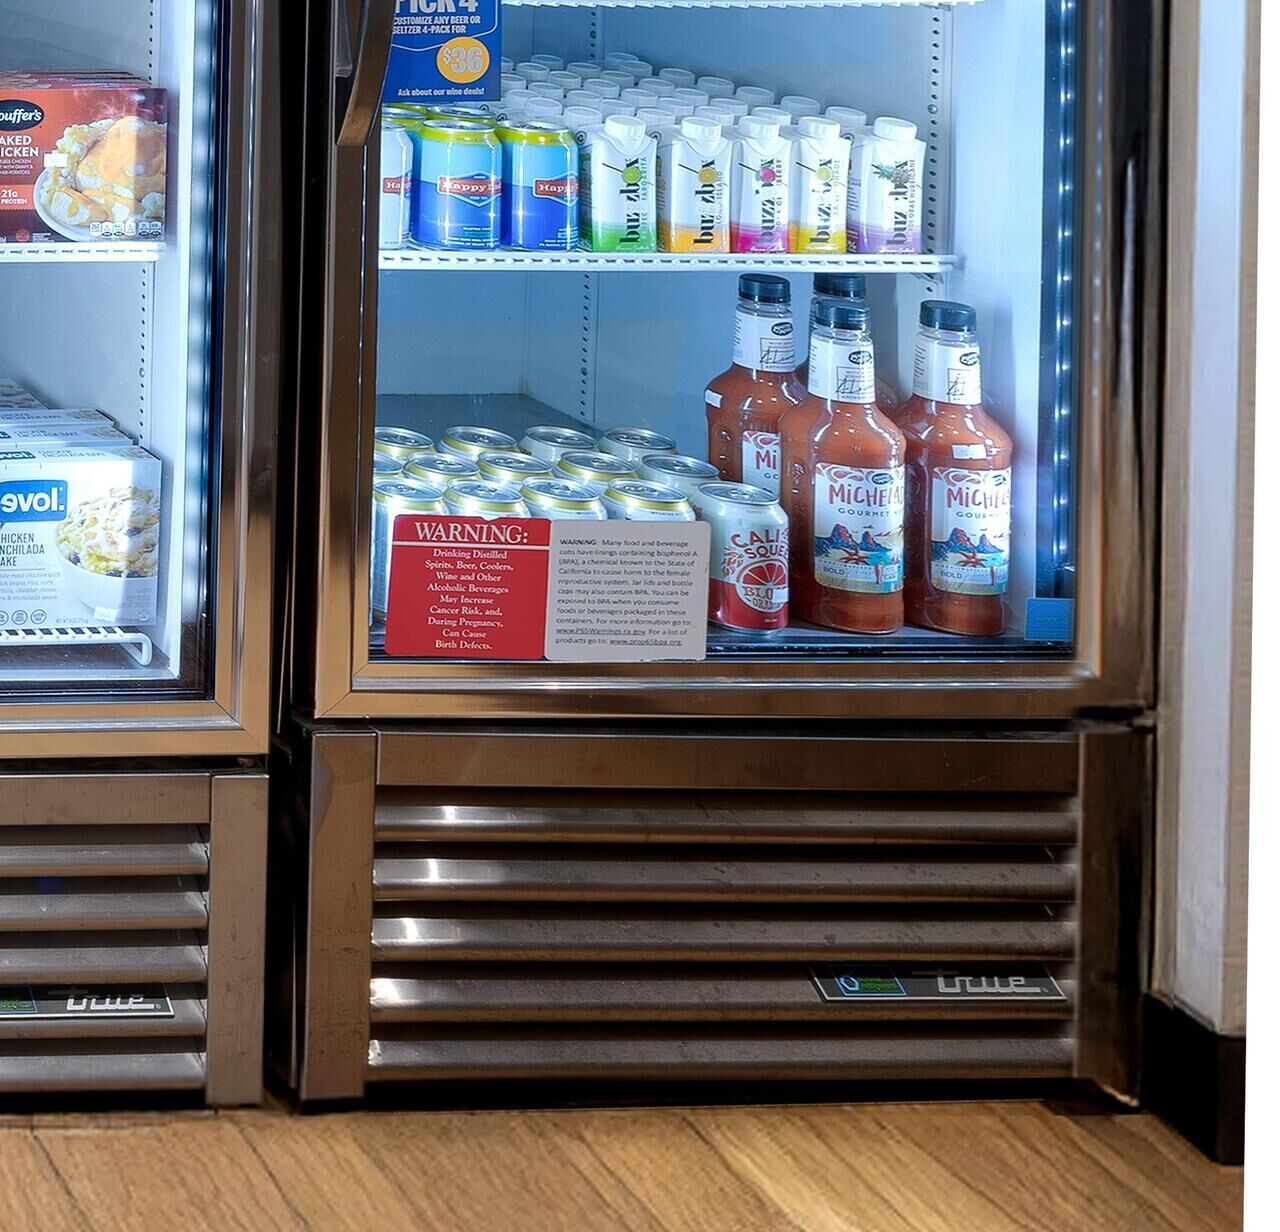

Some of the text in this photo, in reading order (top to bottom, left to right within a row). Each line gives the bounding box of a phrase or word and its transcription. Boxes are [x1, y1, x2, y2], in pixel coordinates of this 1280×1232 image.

[393, 16, 481, 25] CUSTOMIZE ANY BEER OR
[392, 25, 467, 35] SELTZER 4-PACK FOR
[443, 46, 484, 74] $36
[398, 88, 411, 97] Ask
[411, 88, 433, 96] about
[463, 87, 485, 95] deals!
[415, 522, 529, 544] WARNING:
[433, 548, 508, 559] Drinking Distilled
[436, 571, 502, 582] Wine and Other
[426, 583, 509, 594] Alcoholic Beverages
[439, 595, 495, 605] May Increase
[429, 606, 460, 615] Cancer
[428, 617, 458, 627] During
[442, 628, 488, 638] Can Cause
[435, 639, 493, 650] Birth Defects.
